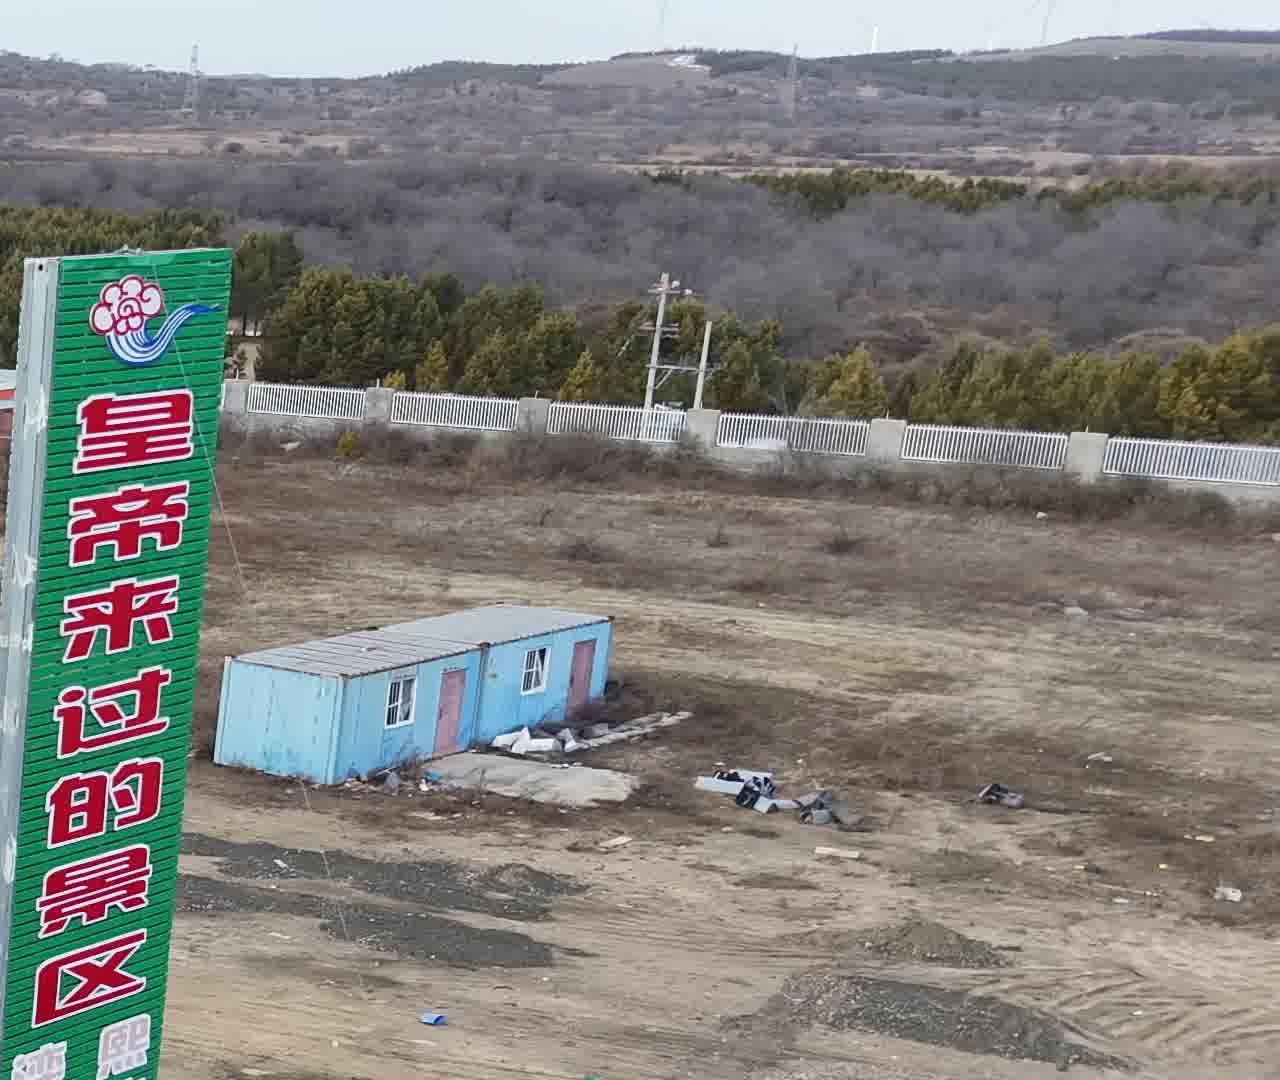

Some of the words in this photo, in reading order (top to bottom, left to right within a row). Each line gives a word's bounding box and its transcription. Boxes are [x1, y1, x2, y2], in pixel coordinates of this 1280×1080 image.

[32, 389, 195, 1028] 皇帝来过的景区
